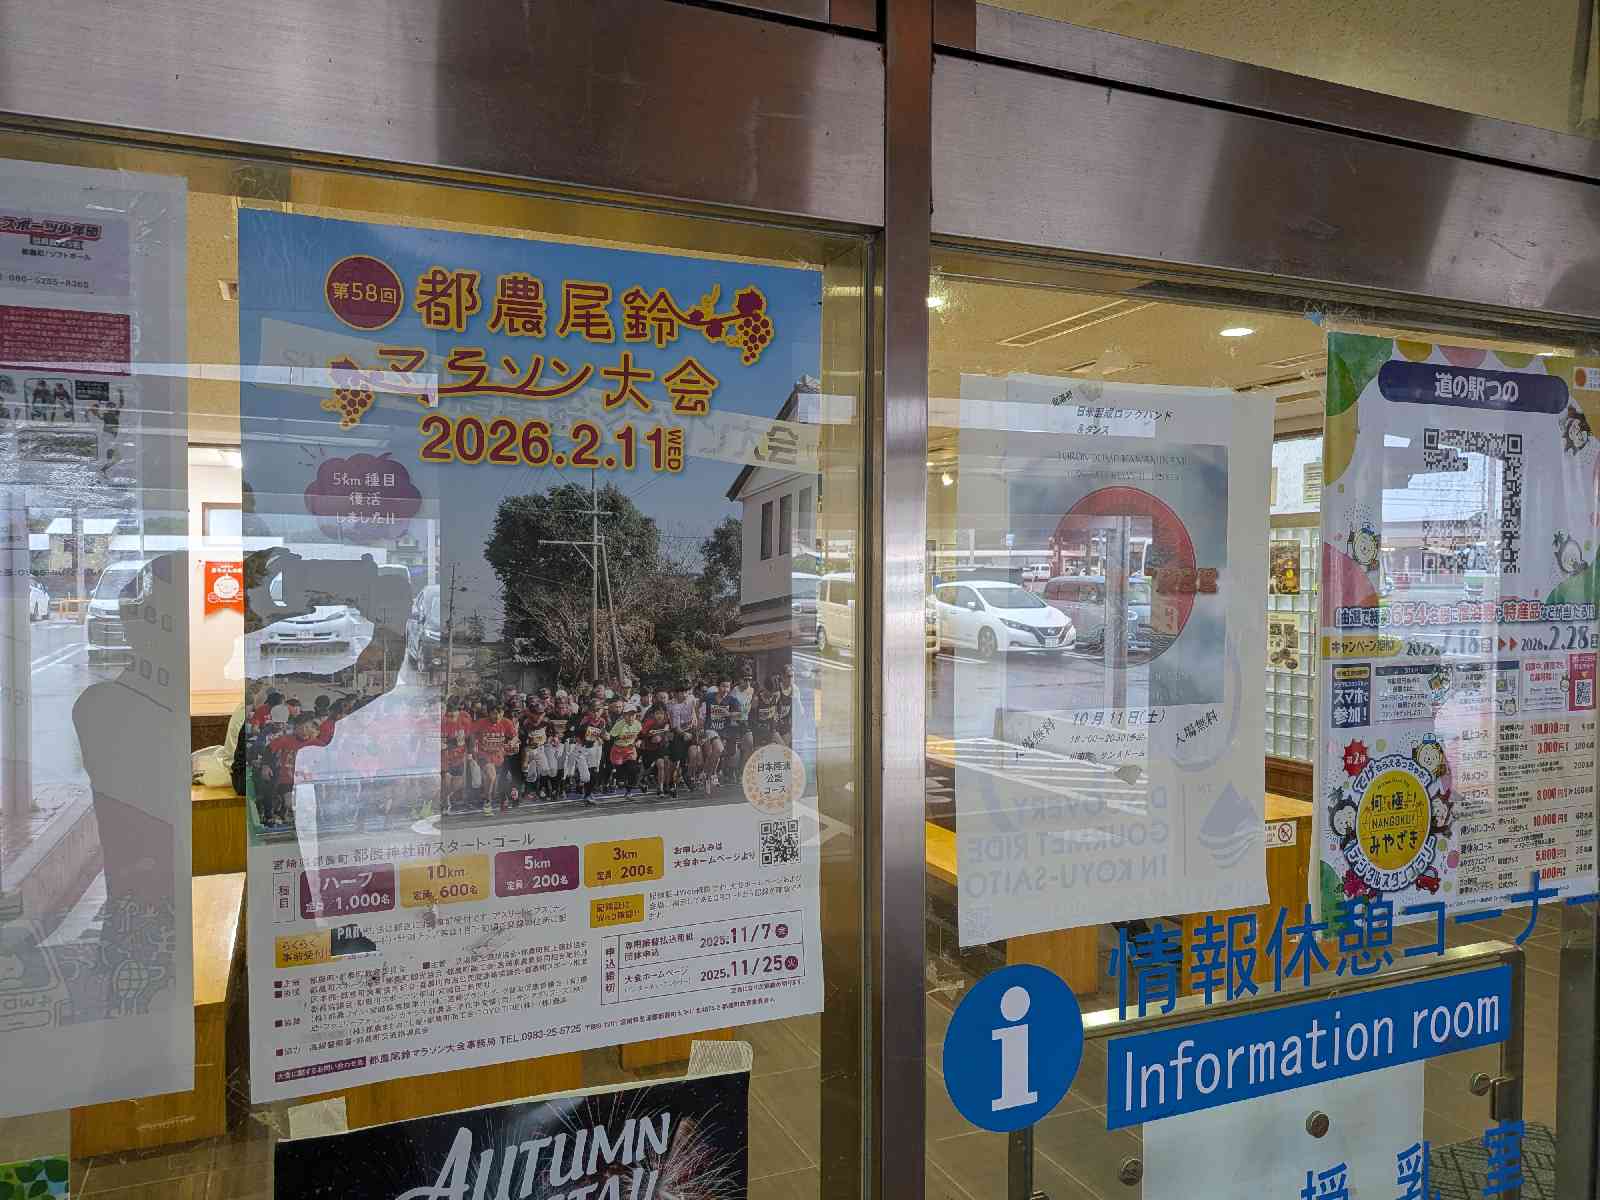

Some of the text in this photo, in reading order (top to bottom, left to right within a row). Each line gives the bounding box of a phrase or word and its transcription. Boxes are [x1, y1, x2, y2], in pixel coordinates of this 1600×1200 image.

[332, 282, 397, 305] 第58回
[416, 267, 682, 347] 都農尾鈴
[375, 346, 719, 416] マラソン大会
[1434, 372, 1519, 403] 道の駅つの
[420, 415, 665, 473] 2026.2.11
[668, 426, 684, 472] WED
[333, 472, 395, 487] 5km 種目
[1334, 687, 1369, 704] スマホで
[1334, 706, 1368, 725] 参加!
[1370, 830, 1418, 856] みやざき
[524, 855, 551, 870] 5km
[613, 845, 638, 861] 3km
[322, 871, 374, 890] ハーフ
[427, 864, 465, 880] 10km
[532, 873, 569, 889] 200名
[620, 864, 655, 880] 200名
[439, 883, 480, 898] 600名
[700, 923, 771, 949] 2025.11/7
[700, 955, 782, 982] 2025.11/25
[1124, 993, 1500, 1112] Information room
